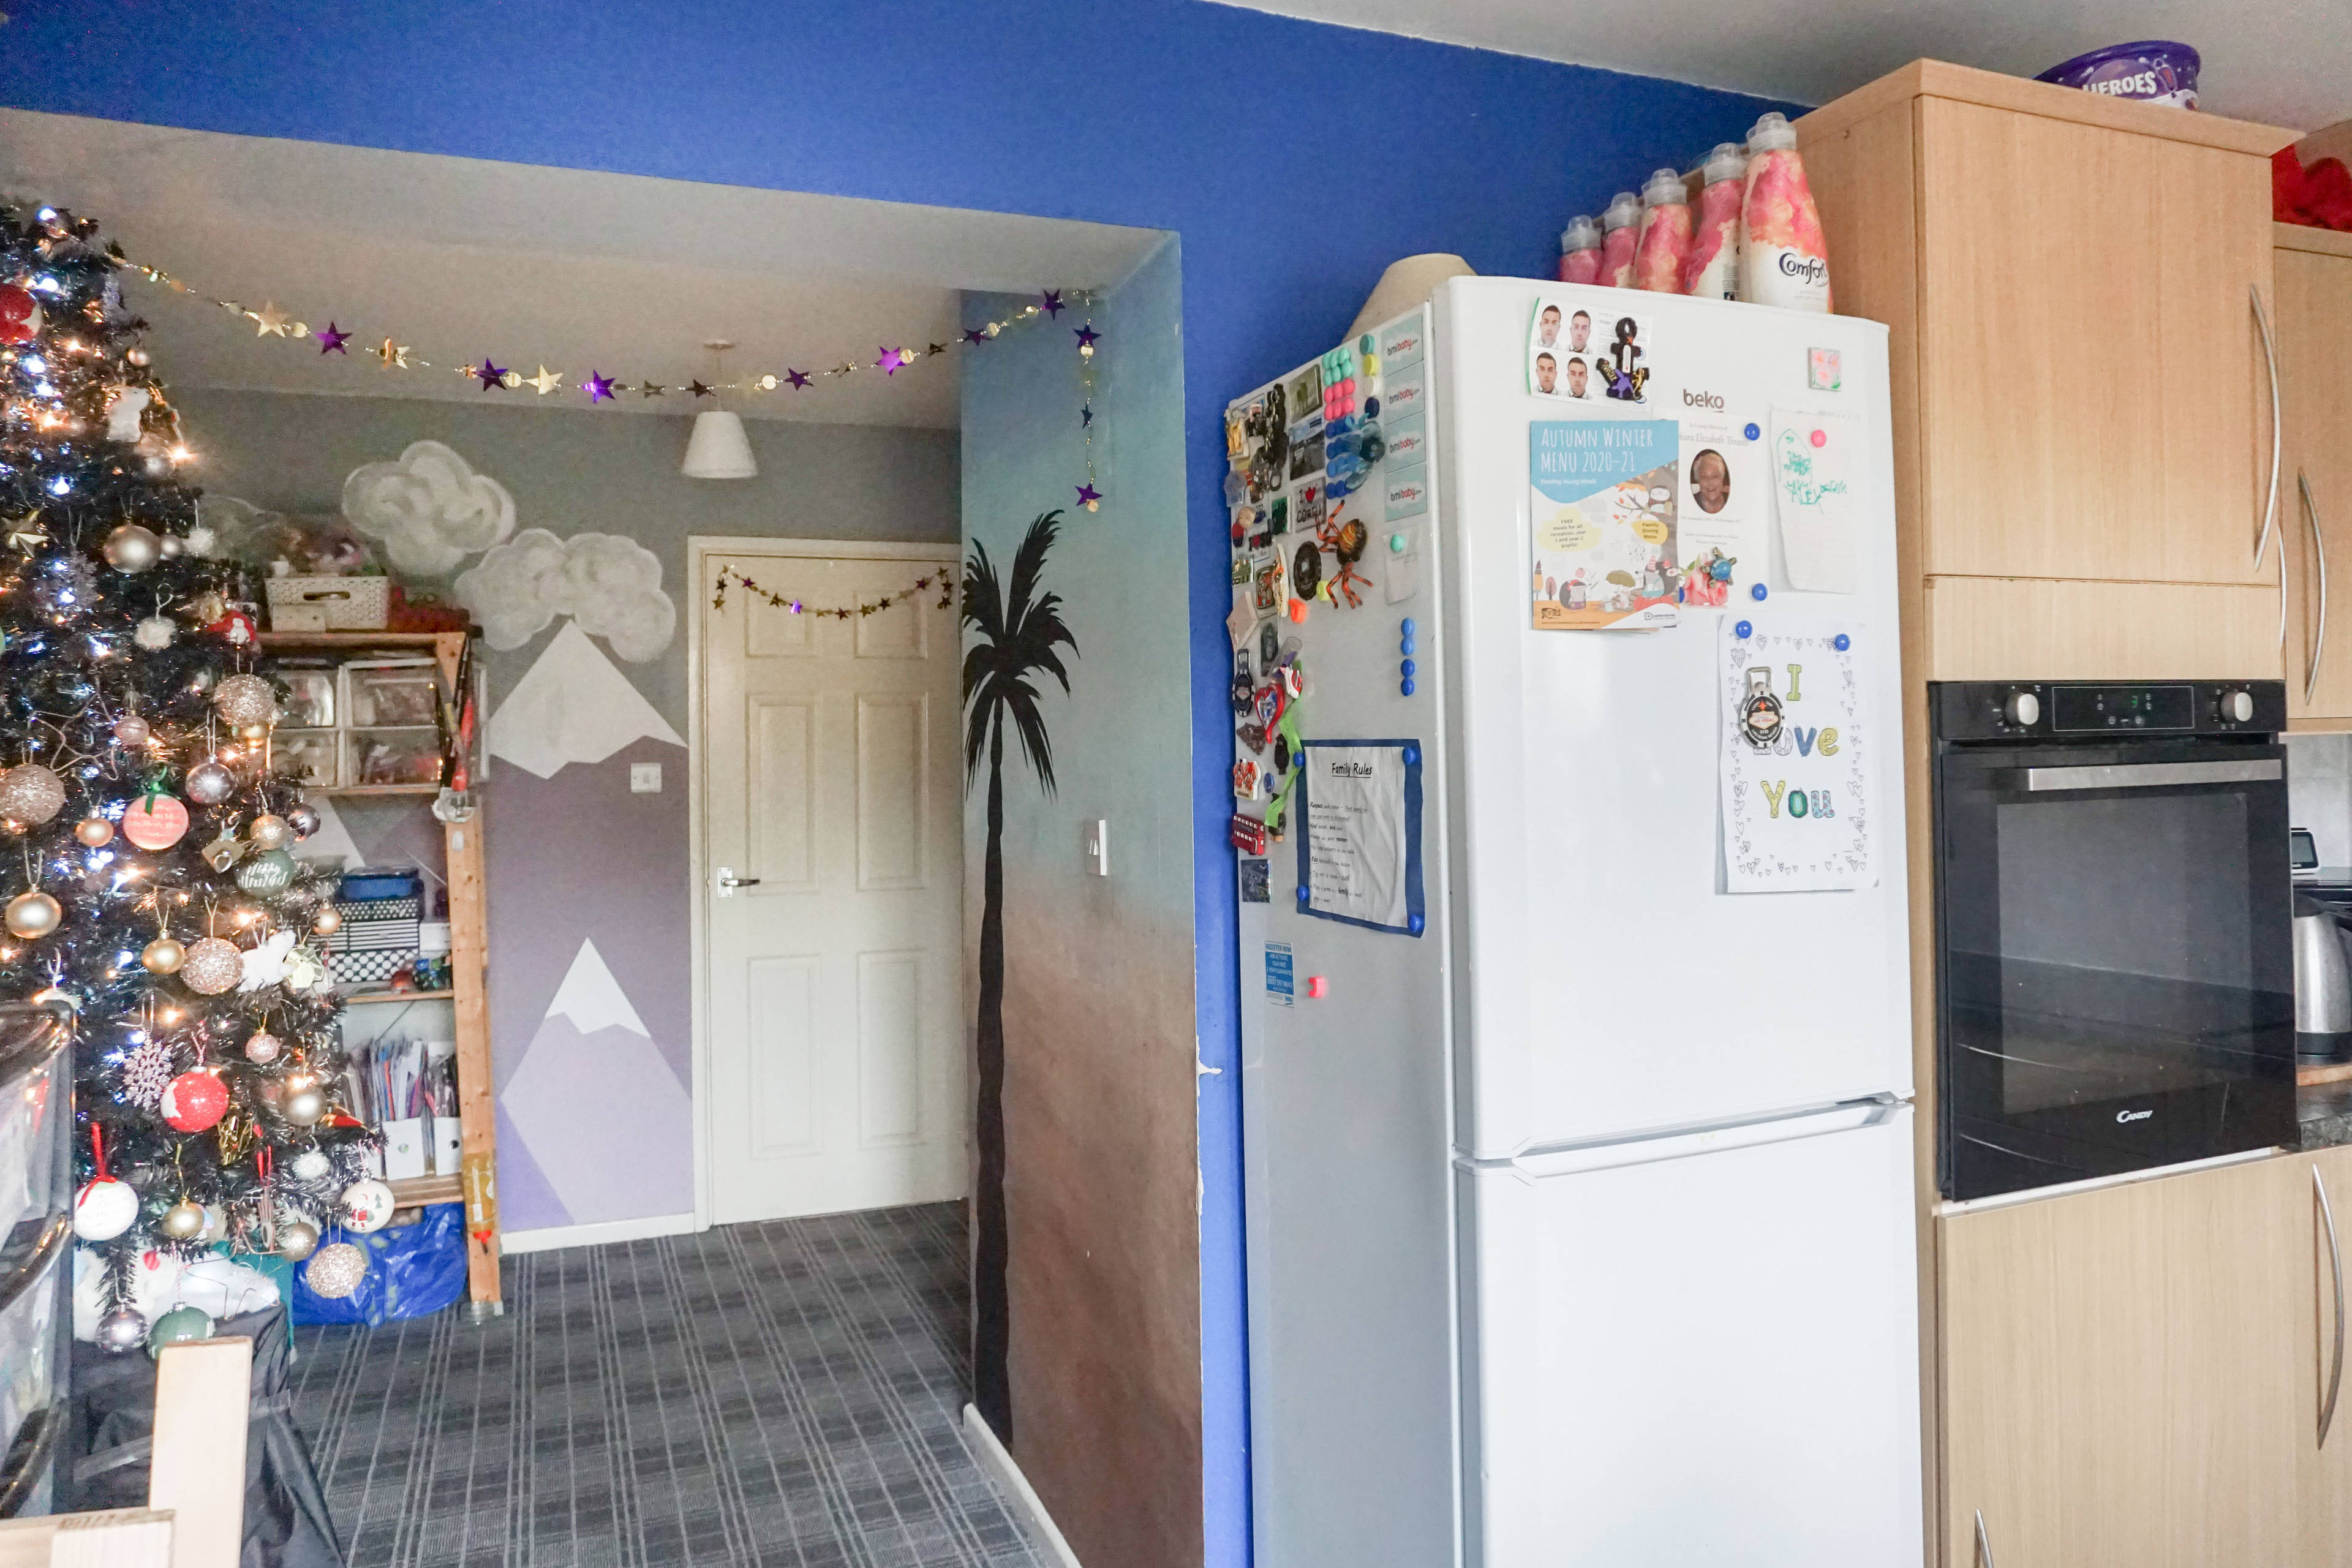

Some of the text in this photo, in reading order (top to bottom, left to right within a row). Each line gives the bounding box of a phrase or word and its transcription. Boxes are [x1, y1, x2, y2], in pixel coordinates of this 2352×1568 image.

[2082, 71, 2157, 95] HEROES
[1683, 388, 1725, 409] beko
[1542, 428, 1654, 448] AUTUMN WINTER
[1679, 432, 1694, 442] bara
[1695, 433, 1725, 443] Elizabeth
[1541, 451, 1577, 472] MENU
[1297, 489, 1322, 522] I CORFU
[1787, 664, 1802, 701] I
[1753, 726, 1839, 757] ove
[1332, 763, 1373, 777] Family Rules
